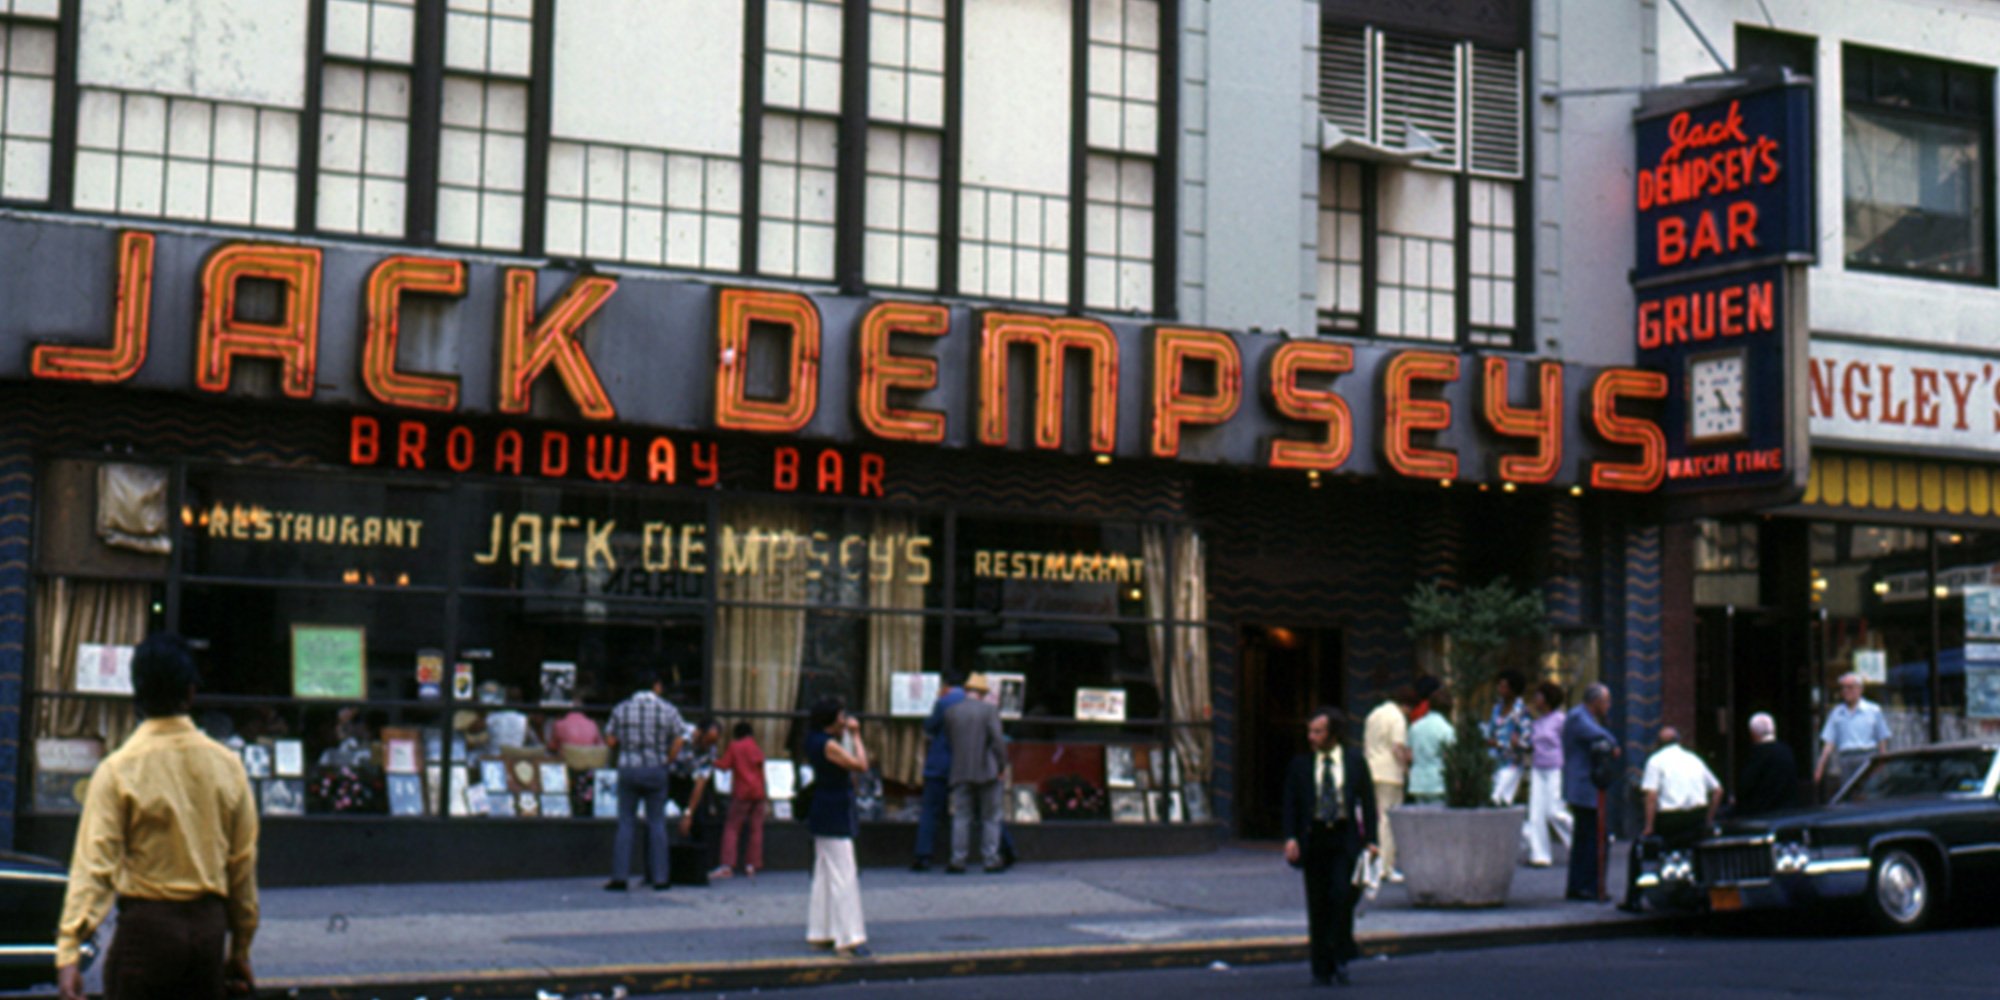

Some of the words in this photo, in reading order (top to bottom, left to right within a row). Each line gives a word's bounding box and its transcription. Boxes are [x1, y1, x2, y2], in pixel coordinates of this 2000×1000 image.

[1661, 99, 1748, 165] Jack
[1637, 134, 1779, 211] DEMPSEY'S
[1656, 201, 1758, 266] BAR
[1638, 281, 1773, 349] GRUEN
[32, 231, 619, 420] JACK
[715, 288, 1668, 493] DEMPSEYS
[1809, 357, 2000, 433] NGLEY'
[350, 416, 718, 486] BROADWAY
[773, 446, 885, 497] BAR
[1667, 453, 1730, 479] WATCH
[1735, 447, 1783, 474] TIME
[208, 506, 424, 549] RESTAURANT
[473, 511, 617, 571] JACK
[974, 551, 1146, 584] RESTAURANT
